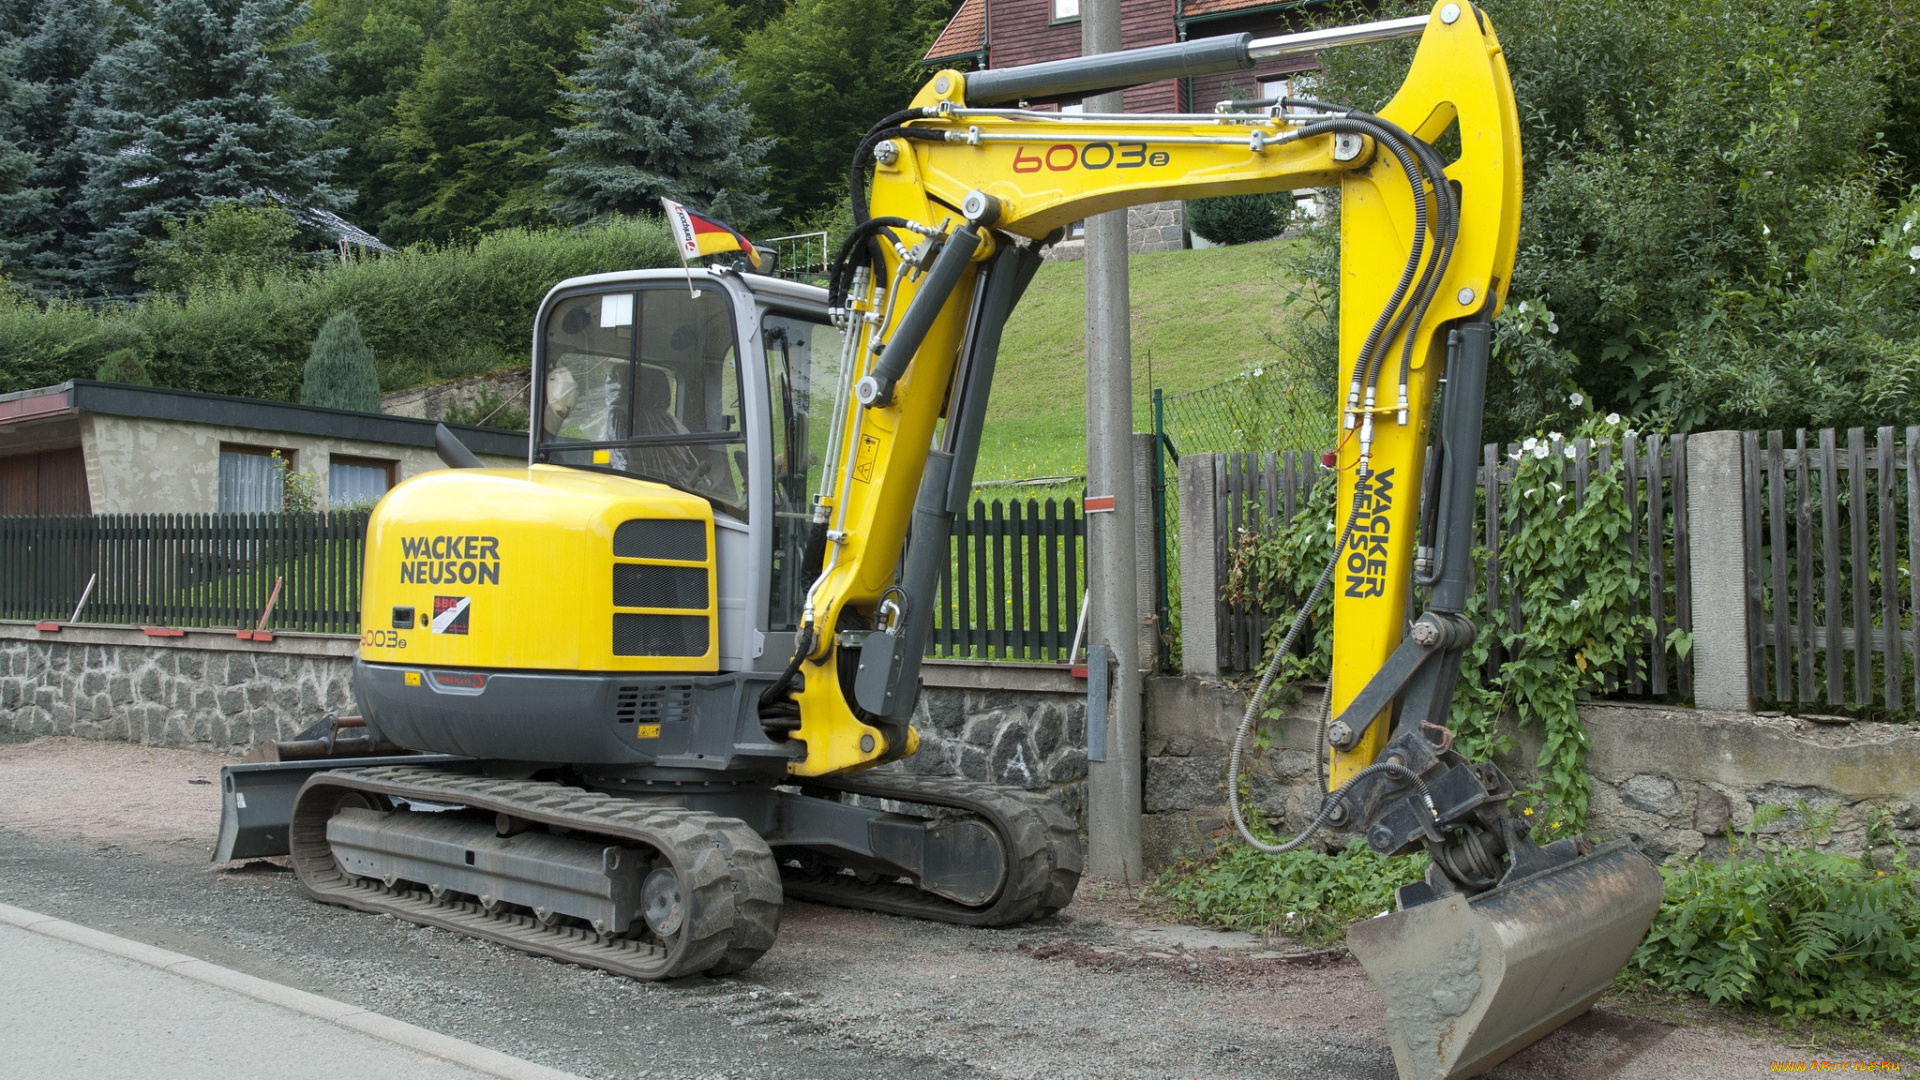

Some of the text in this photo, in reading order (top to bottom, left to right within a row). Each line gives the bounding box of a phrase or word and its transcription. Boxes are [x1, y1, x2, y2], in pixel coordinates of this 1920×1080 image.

[400, 536, 500, 560] WACKER
[1344, 468, 1374, 599] NEUSON
[1364, 467, 1395, 599] WACKER
[400, 561, 500, 585] NEUSON
